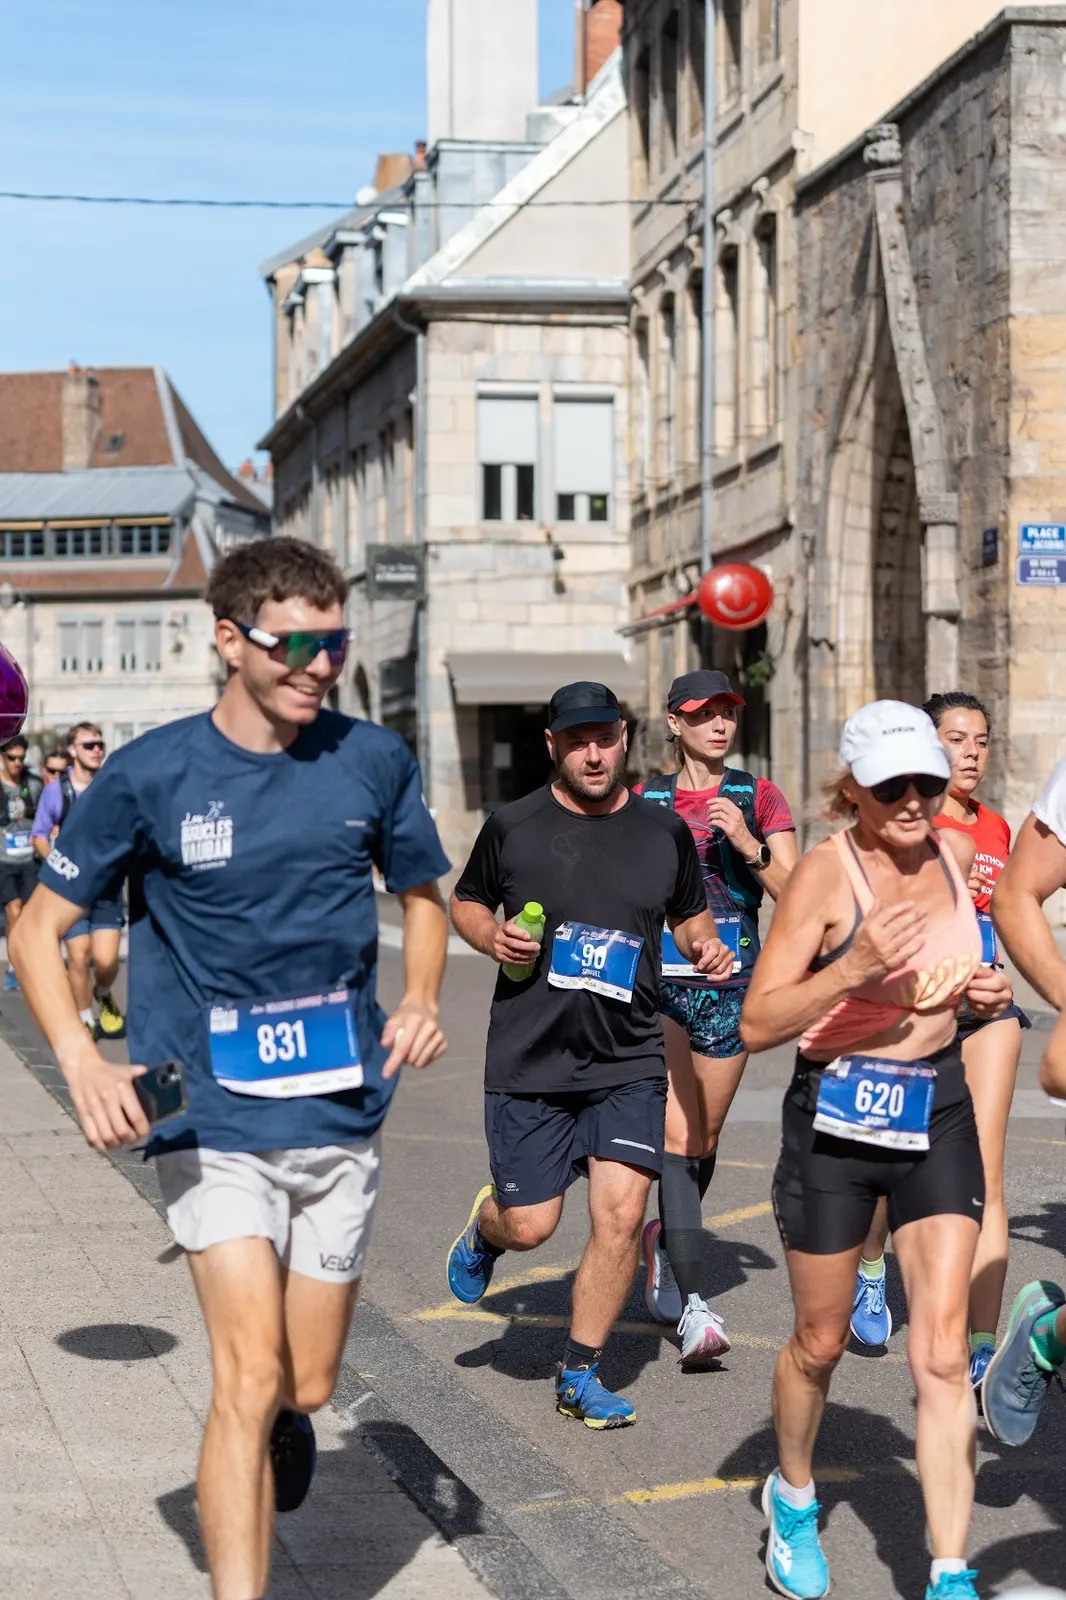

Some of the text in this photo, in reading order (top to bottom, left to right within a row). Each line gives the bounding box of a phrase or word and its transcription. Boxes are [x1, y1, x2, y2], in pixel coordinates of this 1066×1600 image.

[1027, 526, 1059, 539] PLACE
[181, 836, 233, 866] VAUBAN
[979, 864, 993, 875] KM
[581, 943, 608, 970] 90
[257, 1019, 308, 1065] 831
[855, 1079, 905, 1118] 620
